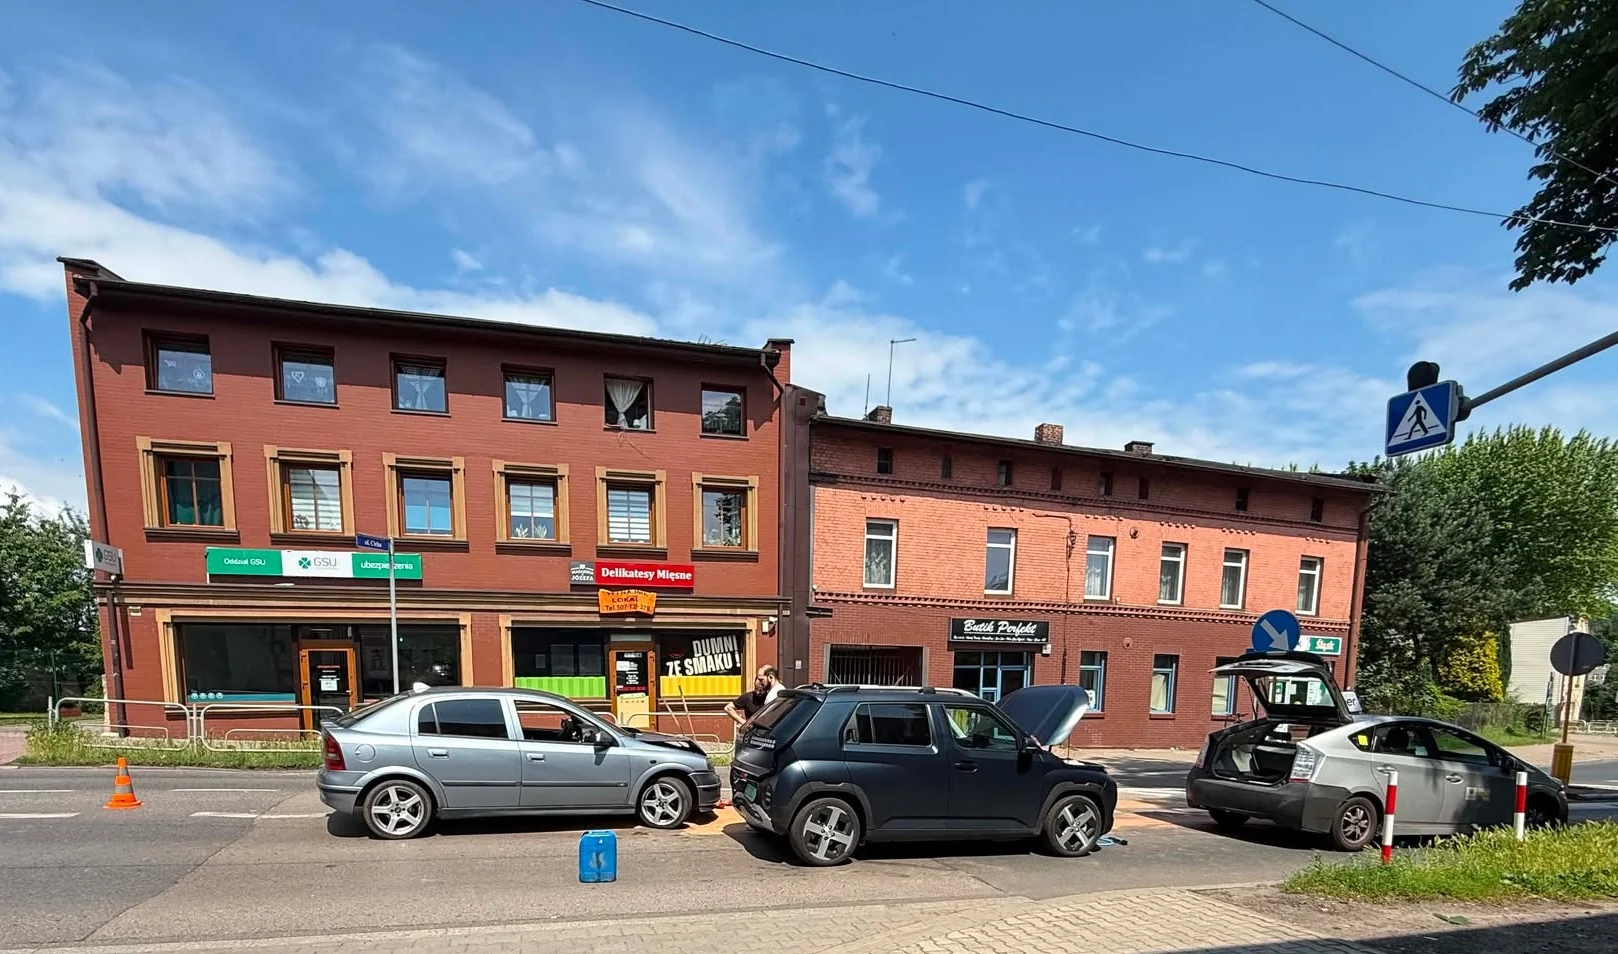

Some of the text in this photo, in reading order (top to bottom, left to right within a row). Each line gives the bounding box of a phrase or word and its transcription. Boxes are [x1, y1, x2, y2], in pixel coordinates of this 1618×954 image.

[105, 549, 116, 562] GSU
[250, 558, 266, 566] GSU
[313, 557, 337, 567] GSU
[360, 562, 413, 571] ubezpiezenia
[601, 567, 692, 582] Delikatesy Mięsne
[963, 619, 1037, 636] Butik Perfekt
[692, 635, 738, 657] DUMNI
[665, 660, 682, 676] ZE
[684, 652, 733, 675] SMAKU
[1346, 698, 1356, 707] er
